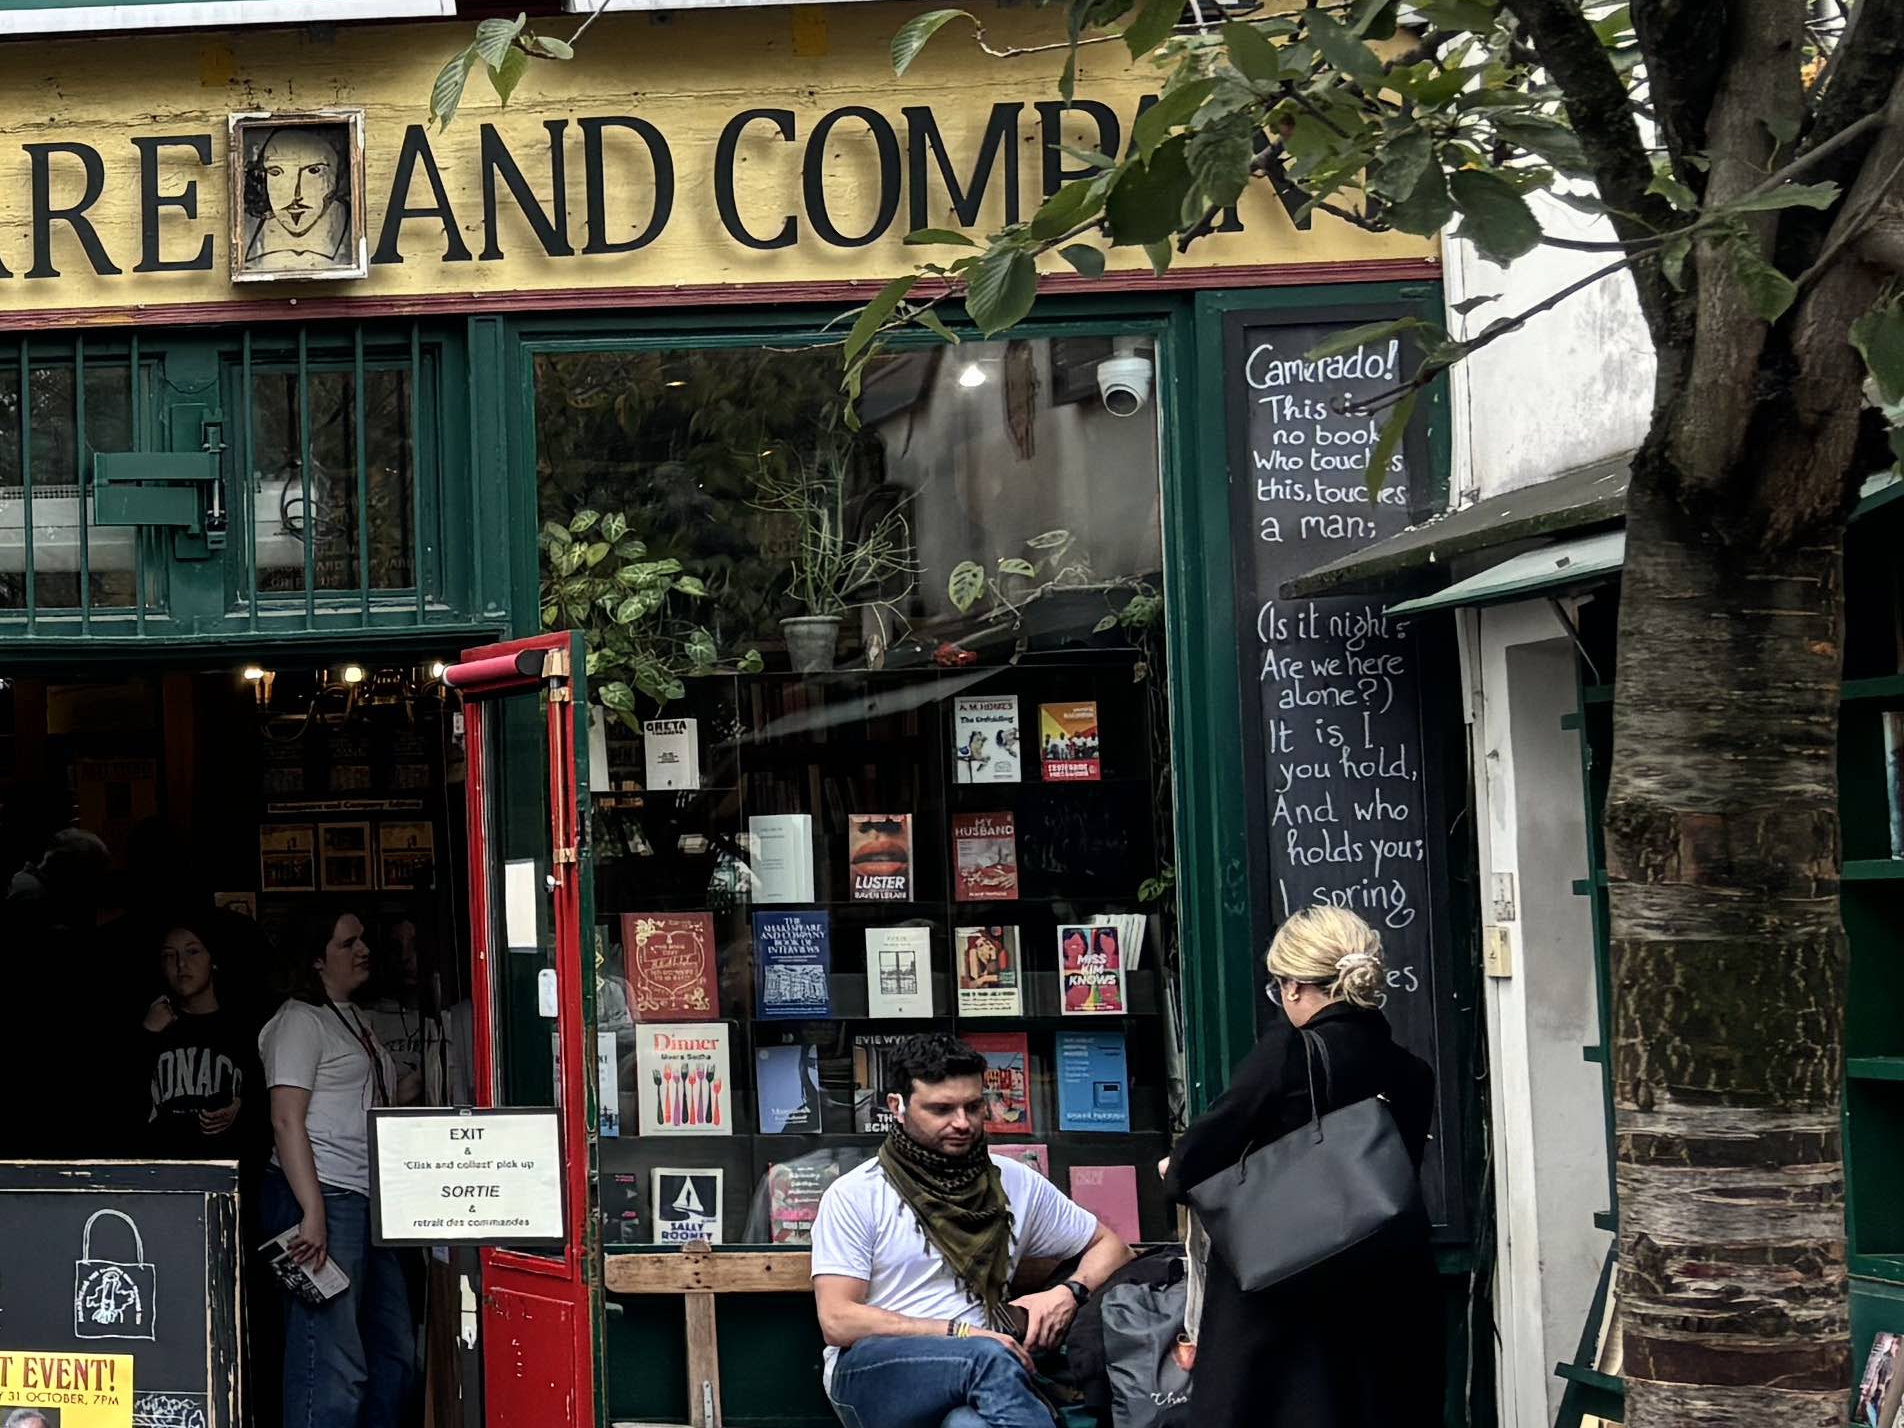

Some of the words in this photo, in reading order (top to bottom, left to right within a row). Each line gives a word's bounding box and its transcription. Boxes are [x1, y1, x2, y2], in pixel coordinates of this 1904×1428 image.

[373, 115, 673, 265] AND
[713, 94, 1388, 249] COMP
[1245, 340, 1398, 389] Camerado!
[1258, 395, 1327, 423] This
[1273, 430, 1305, 445] no
[1316, 419, 1381, 446] book
[1253, 450, 1303, 470] Who
[1311, 448, 1403, 472] toucs
[1258, 478, 1312, 502] this,
[1315, 478, 1407, 504] touces
[1261, 517, 1283, 542] a
[1301, 515, 1376, 539] man;
[1257, 601, 1287, 643] (Is
[1298, 602, 1320, 638] it
[1260, 649, 1304, 681] Are
[1311, 658, 1342, 676] we
[1346, 651, 1404, 676] here
[1279, 676, 1392, 714] alone?)
[646, 721, 686, 732] GRETA
[1270, 719, 1294, 753] It
[1316, 719, 1343, 747] is
[1363, 712, 1373, 748] I
[1275, 763, 1331, 793] you
[1340, 744, 1417, 781] hold,
[1272, 791, 1339, 826] And
[1354, 788, 1408, 821] who
[955, 825, 1014, 836] HUSBAND
[1287, 829, 1363, 866] holds
[1370, 840, 1423, 878] you;
[855, 876, 905, 889] LUSTER
[1280, 879, 1289, 917] I
[1313, 879, 1416, 928] spring
[1077, 953, 1108, 965] MISS
[1068, 974, 1117, 986] KNOWS
[653, 1033, 719, 1052] Dinner
[450, 1128, 485, 1140] EXIT
[464, 1147, 471, 1155] &
[435, 1161, 454, 1169] and
[497, 1160, 518, 1169] pick
[521, 1161, 534, 1170] up
[441, 1185, 501, 1198] SORTIE
[413, 1219, 444, 1228] retrait
[446, 1219, 464, 1227] des
[468, 1218, 530, 1227] commandes
[670, 1222, 704, 1232] SALLY
[23, 1357, 116, 1392] EVENT!
[8, 1391, 20, 1402] 31
[26, 1392, 88, 1405] OCTOBER,
[93, 1395, 119, 1405] 7PM
